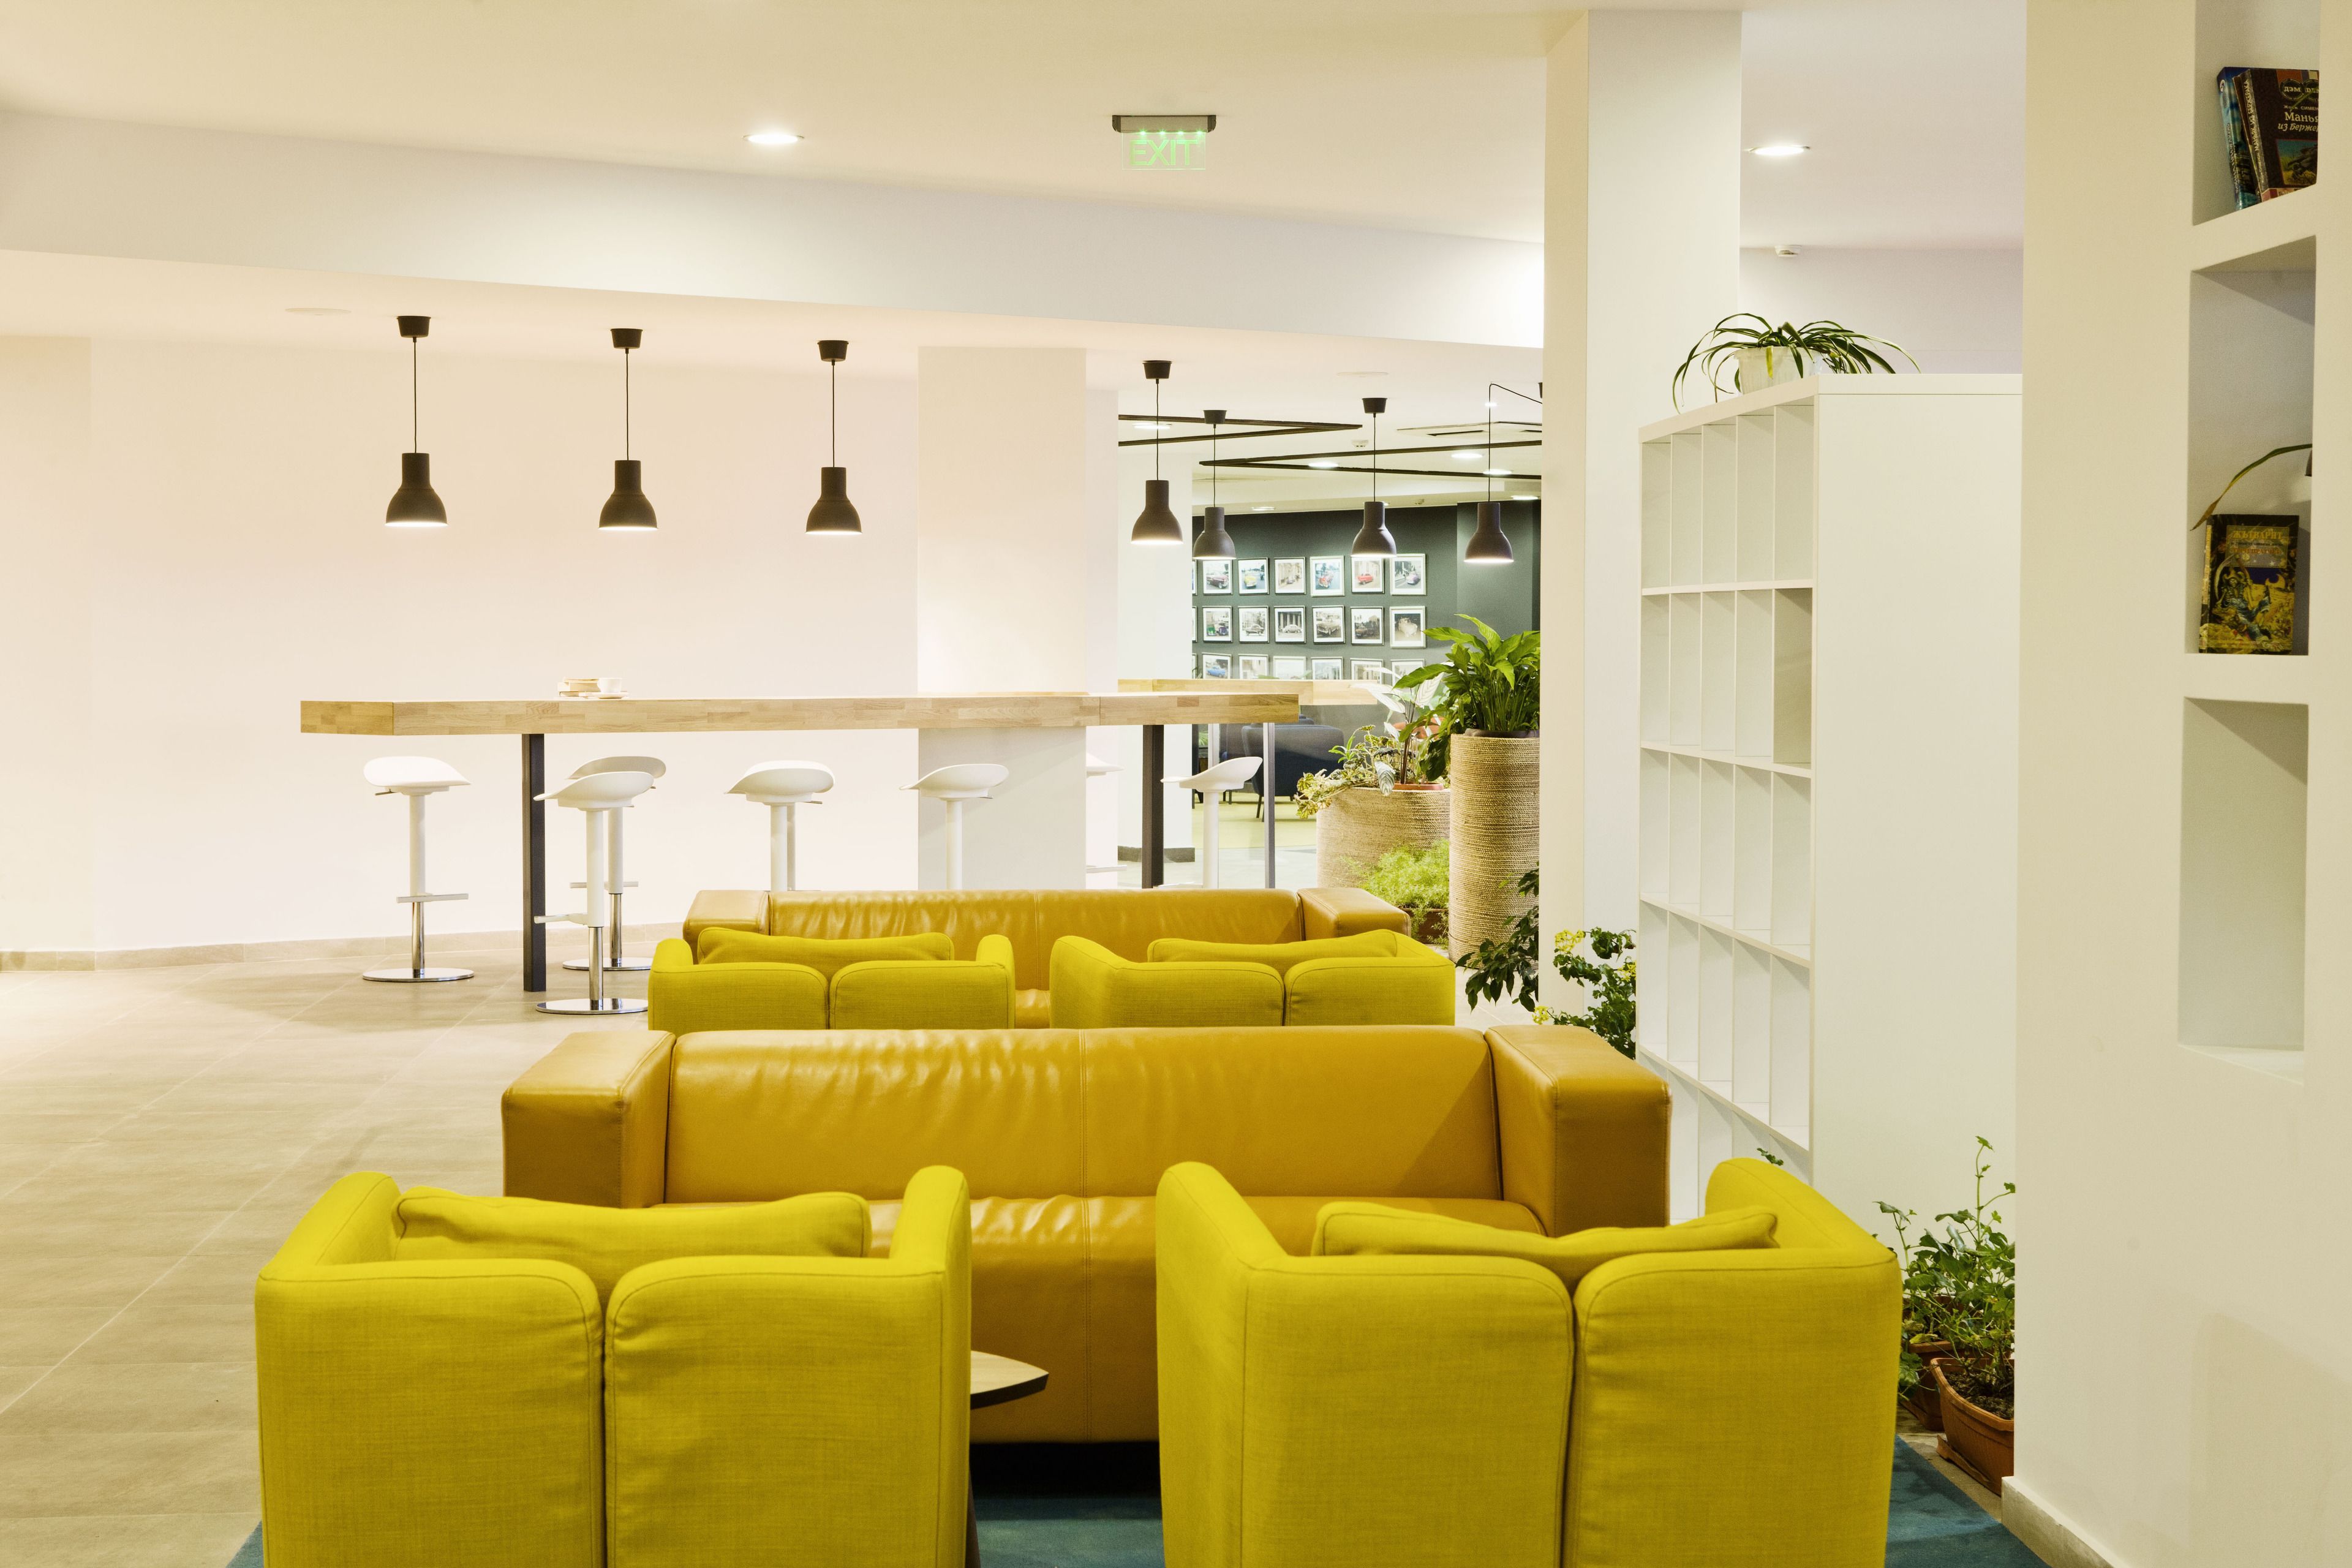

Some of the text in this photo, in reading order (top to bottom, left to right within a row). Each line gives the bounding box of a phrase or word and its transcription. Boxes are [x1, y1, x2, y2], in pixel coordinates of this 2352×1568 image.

[2248, 115, 2255, 126] ИЗ
[2278, 123, 2288, 131] из
[1129, 139, 1199, 165] EXIT
